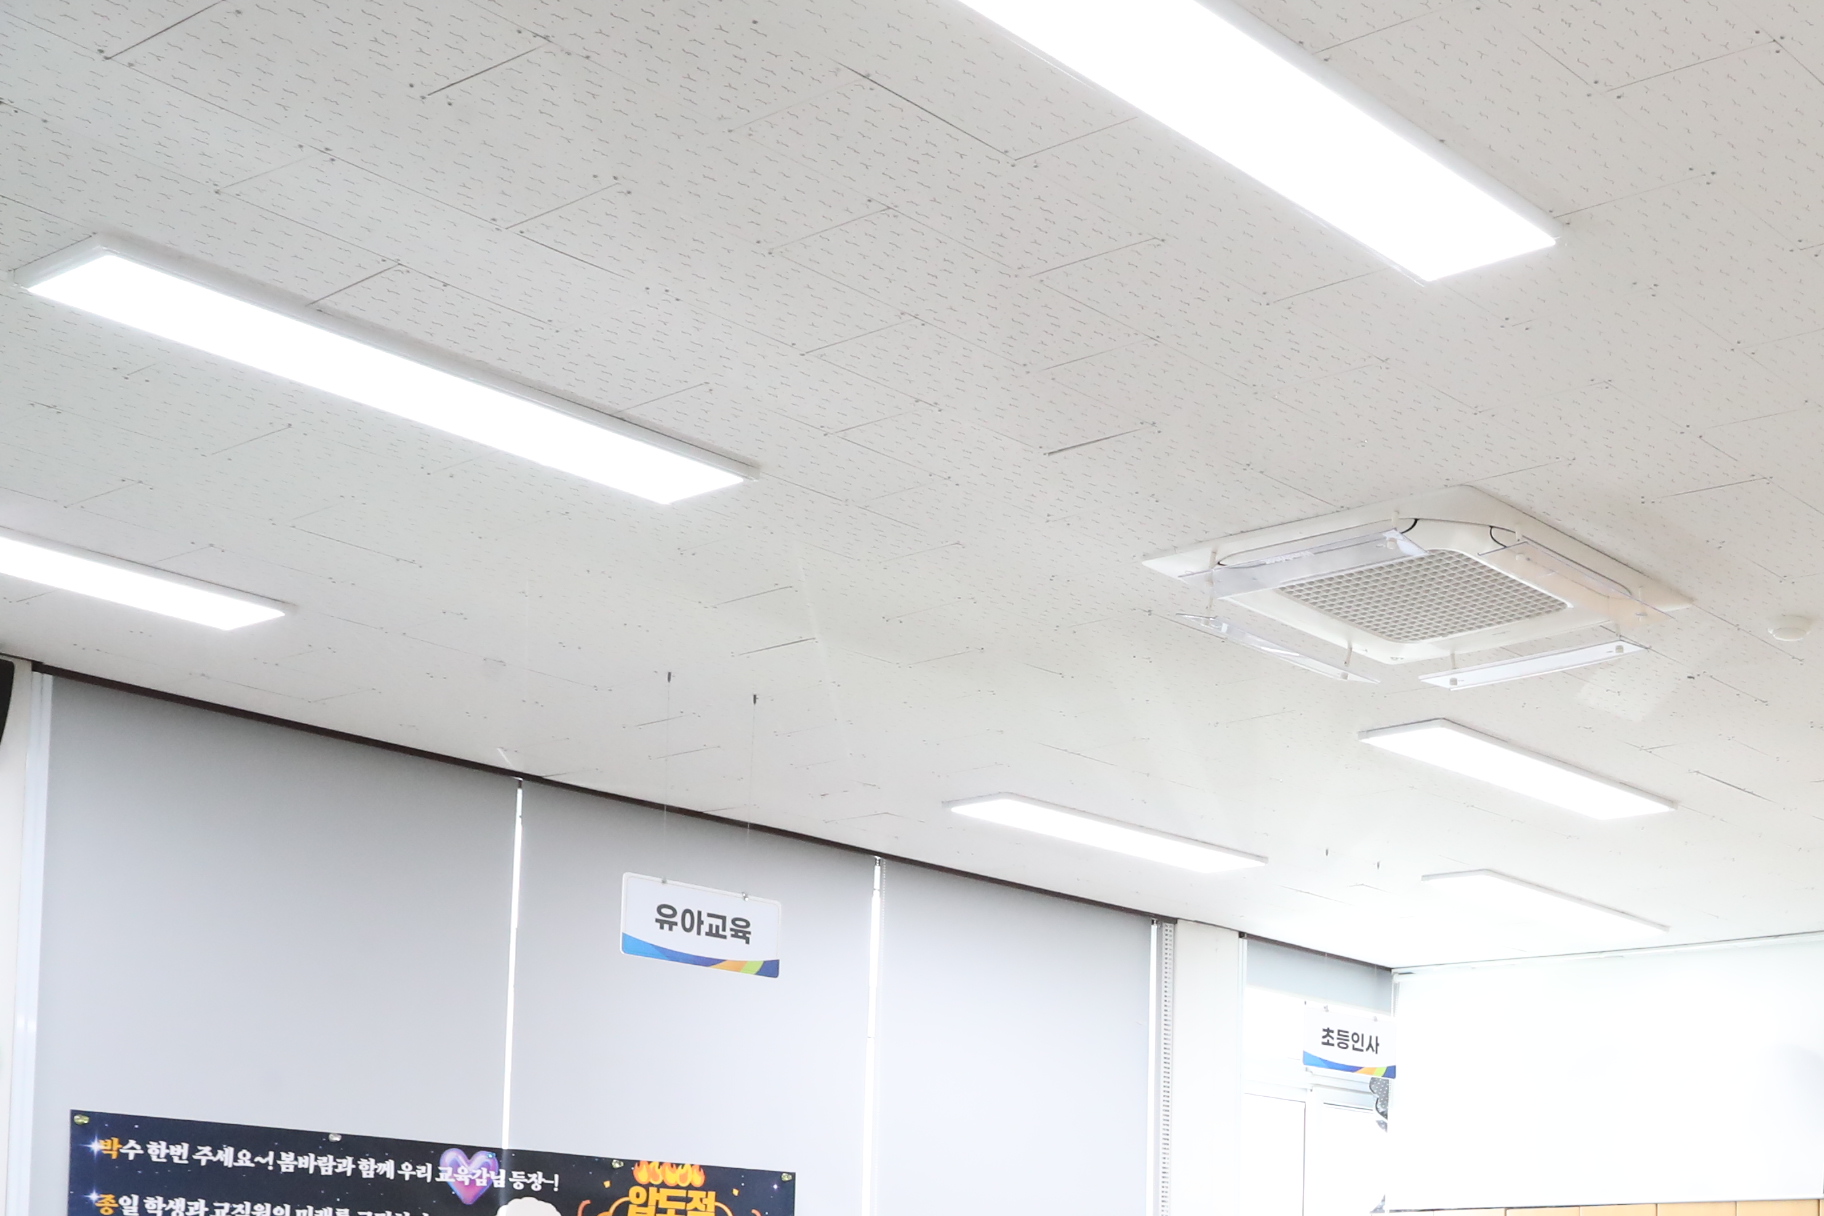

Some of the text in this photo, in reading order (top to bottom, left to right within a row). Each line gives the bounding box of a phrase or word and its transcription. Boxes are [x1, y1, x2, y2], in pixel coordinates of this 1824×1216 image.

[655, 903, 752, 945] 유아교육
[1321, 1027, 1380, 1054] 초등인사
[98, 1137, 560, 1191] 박수 한번 주세요~! 봄바람과 함께 우리 교육감님 등장~!
[95, 1194, 139, 1216] 종일
